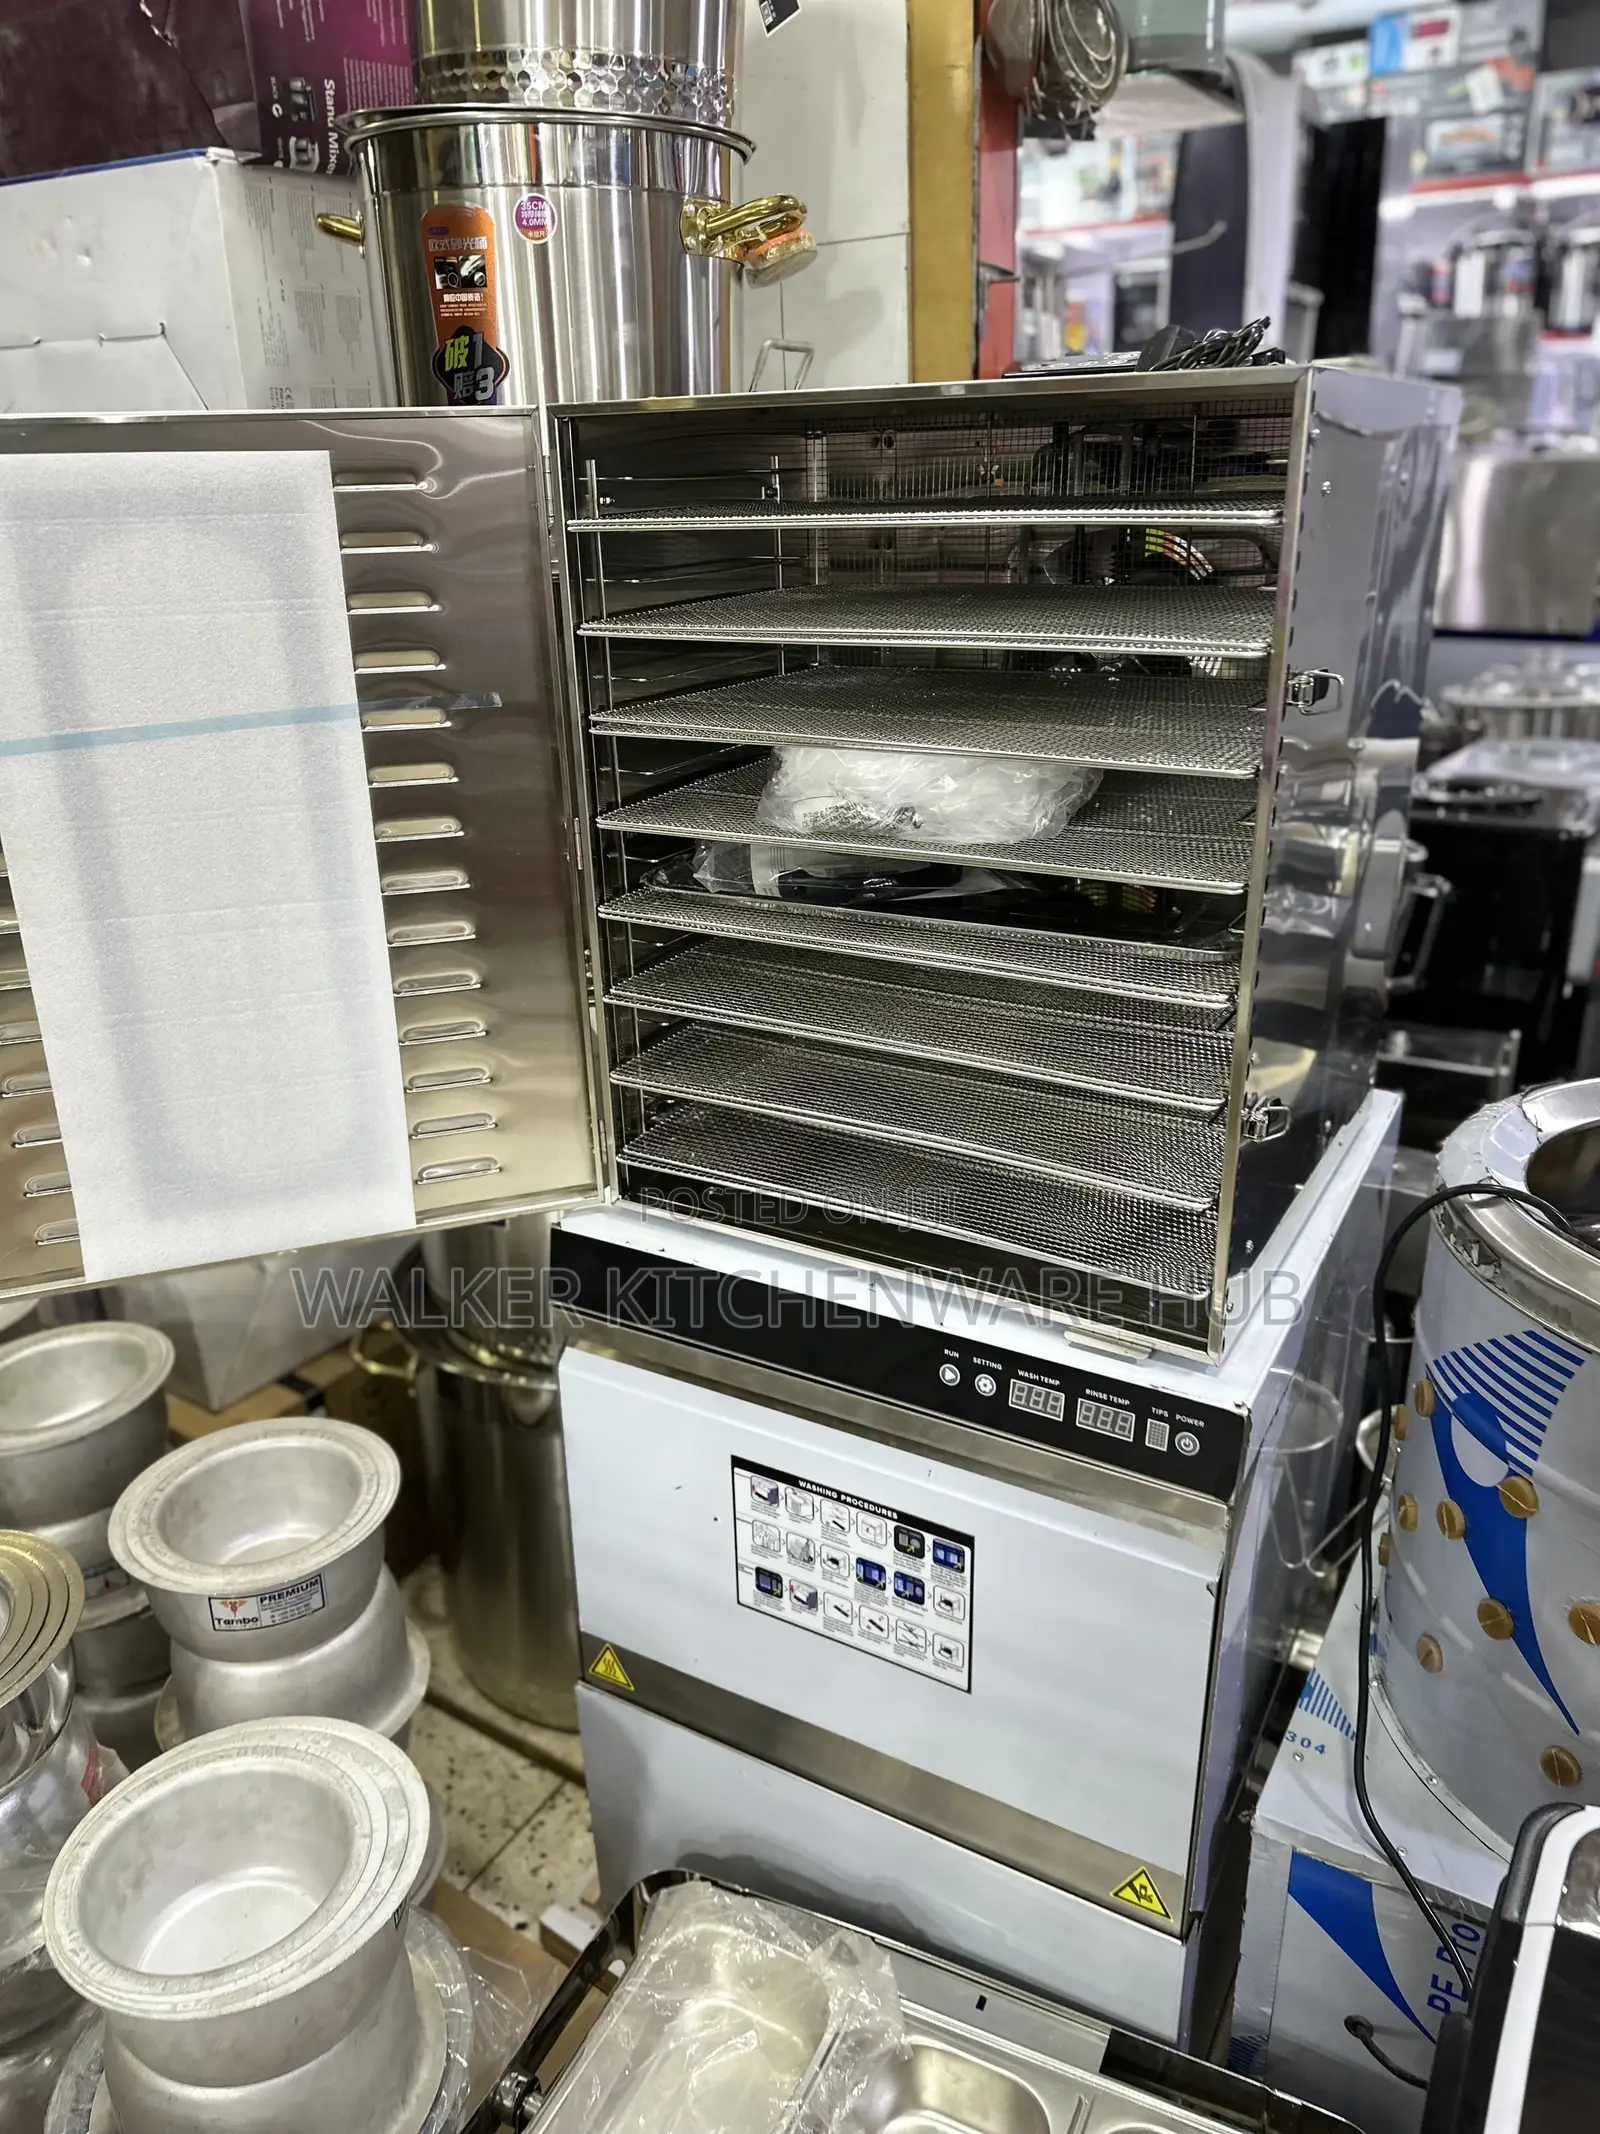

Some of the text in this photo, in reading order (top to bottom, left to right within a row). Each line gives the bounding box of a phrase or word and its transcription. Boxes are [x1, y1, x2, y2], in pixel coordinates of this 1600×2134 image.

[324, 131, 340, 175] Mixer
[520, 200, 548, 211] 35CM
[944, 1348, 960, 1359] RUN
[972, 1356, 1003, 1371] SETTING
[1017, 1369, 1061, 1387] WASH TEMP
[1085, 1388, 1131, 1406] RINSE TEMP
[1151, 1406, 1169, 1418] TIPS
[1175, 1413, 1206, 1429] POWER
[798, 1479, 898, 1520] WASHING PROCEDURES
[260, 1578, 320, 1604] PREMIUM
[214, 1616, 259, 1626] Tambo
[1285, 1730, 1326, 1755] 304
